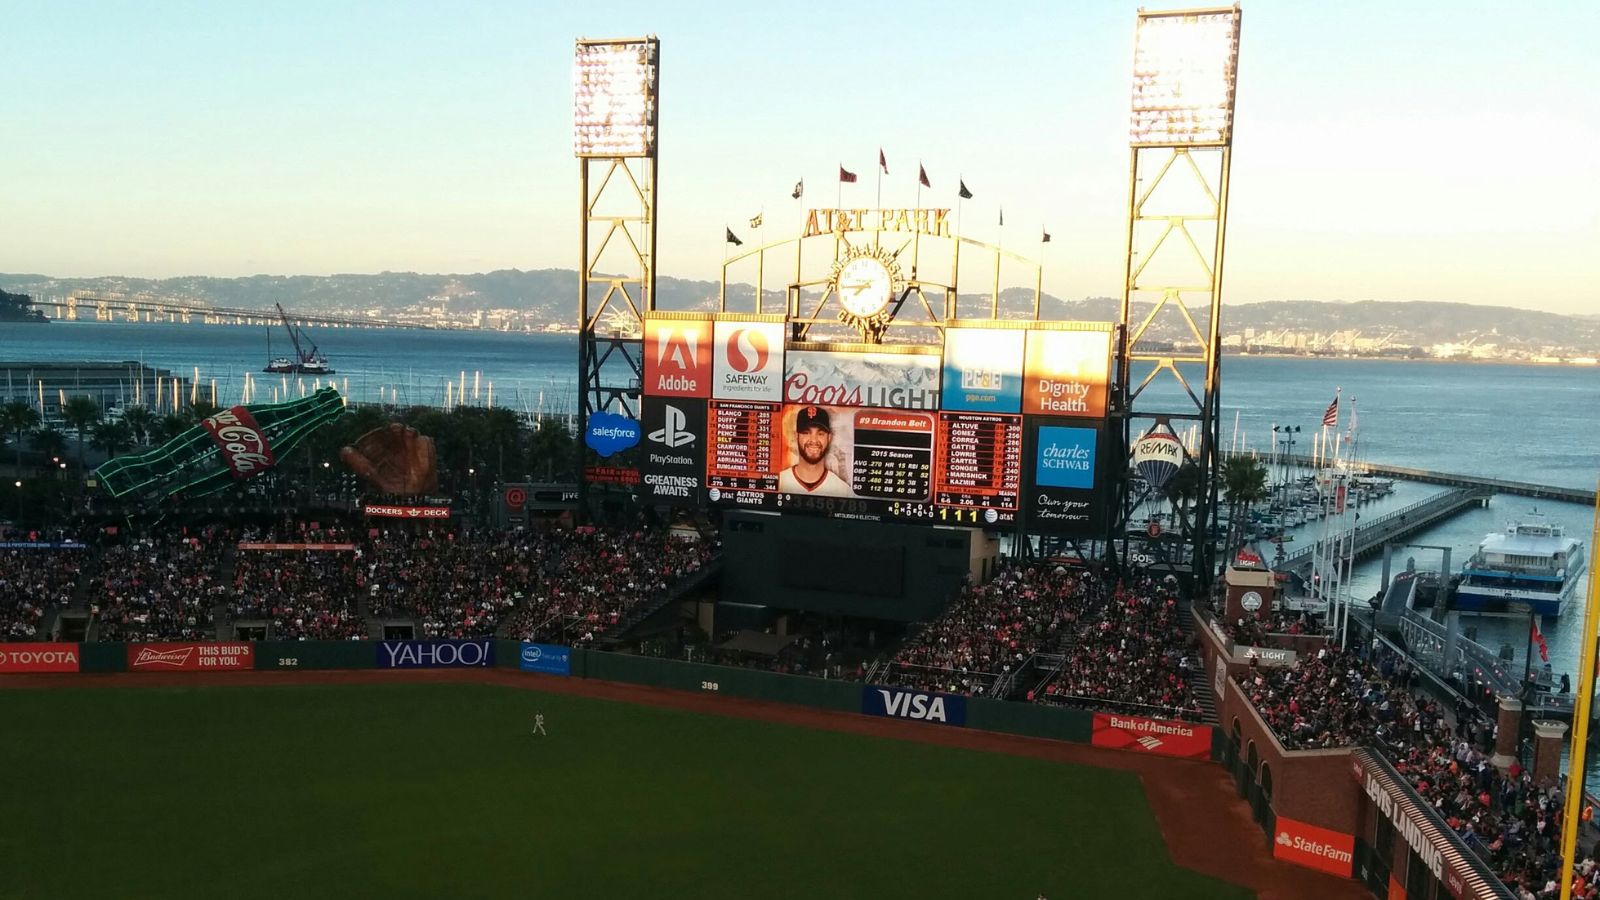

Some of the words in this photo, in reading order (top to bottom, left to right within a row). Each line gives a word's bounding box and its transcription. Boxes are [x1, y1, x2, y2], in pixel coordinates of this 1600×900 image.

[802, 209, 868, 238] AT&T
[881, 208, 951, 238] PARK
[837, 310, 891, 330] GIANTS
[658, 374, 696, 391] Adobe
[726, 374, 768, 384] SAFEWAY
[964, 368, 999, 387] PG&E
[785, 373, 863, 406] Coors
[867, 387, 940, 409] LIGHT
[1039, 380, 1089, 397] Dignity
[872, 418, 907, 426] Brandon
[593, 427, 635, 439] salesforce
[1044, 443, 1090, 458] charles
[1141, 442, 1178, 456] RE/MAX
[650, 454, 692, 465] PlayStation
[1043, 459, 1089, 470] SCHWAB
[644, 475, 697, 487] GREATNESS
[653, 485, 688, 496] AWAITS
[1038, 494, 1061, 505] Own
[1063, 500, 1089, 512] your
[366, 507, 402, 515] DOCKERS
[940, 508, 946, 520] 1
[955, 510, 961, 521] 1
[970, 511, 977, 522] 1
[1038, 509, 1084, 520] tomorrow
[1132, 554, 1149, 562] 501
[140, 651, 187, 662] Budweiser
[199, 647, 219, 655] THIS
[223, 647, 249, 655] BUD'S
[384, 642, 489, 667] YAHOO!
[9, 652, 77, 663] TOYOTA
[199, 657, 216, 665] FOR
[219, 657, 240, 666] YOU.
[701, 681, 718, 690] 399
[877, 690, 947, 722] VISA
[1111, 717, 1137, 730] Bank
[1137, 721, 1148, 731] of
[1150, 722, 1193, 737] America
[1393, 803, 1443, 880] LANDING
